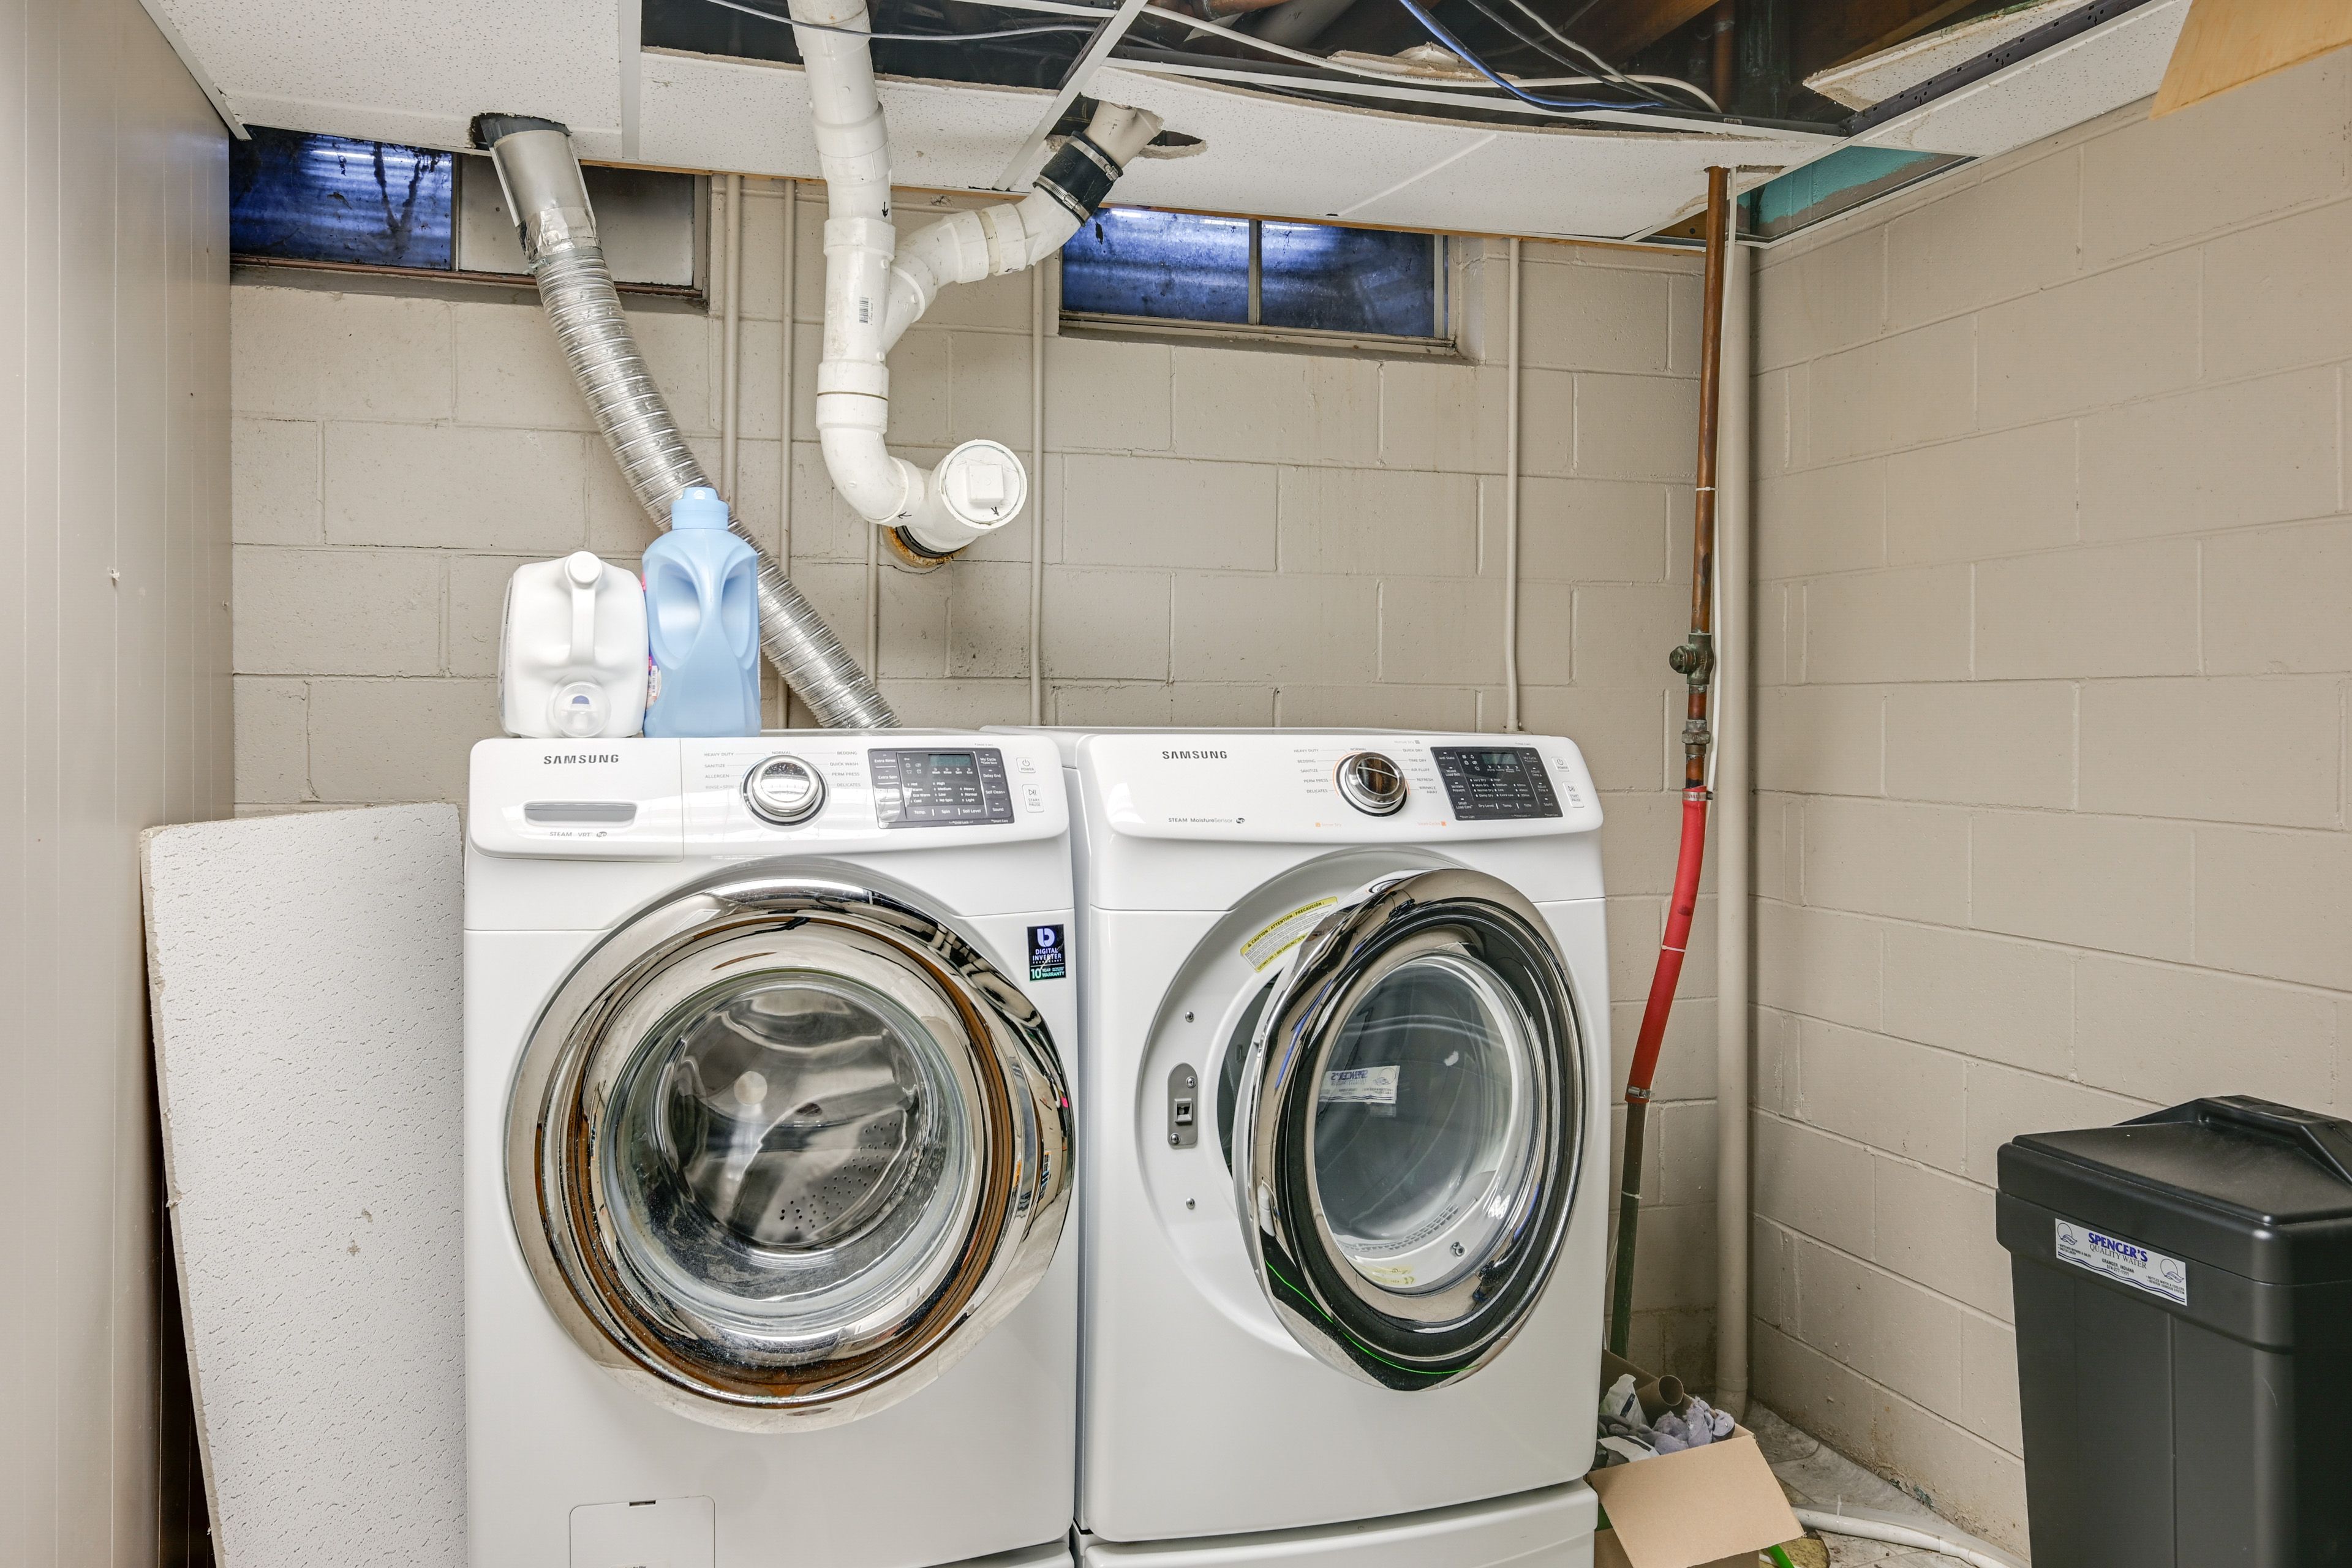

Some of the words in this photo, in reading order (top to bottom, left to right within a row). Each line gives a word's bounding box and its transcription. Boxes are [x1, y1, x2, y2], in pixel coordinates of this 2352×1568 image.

[544, 754, 619, 765] SAMSUNG
[1162, 751, 1227, 760] SAMSUNG
[1251, 930, 1268, 944] CAUTION
[1270, 914, 1293, 930] ATTENTION
[1295, 902, 1322, 916] PRECAUCIÓN
[1030, 968, 1042, 979] 10
[2088, 1232, 2148, 1262] SPENCER'S
[2089, 1243, 2120, 1259] QUALITY
[2122, 1255, 2147, 1269] WATER
[2107, 1265, 2129, 1276] 574-277-1111
